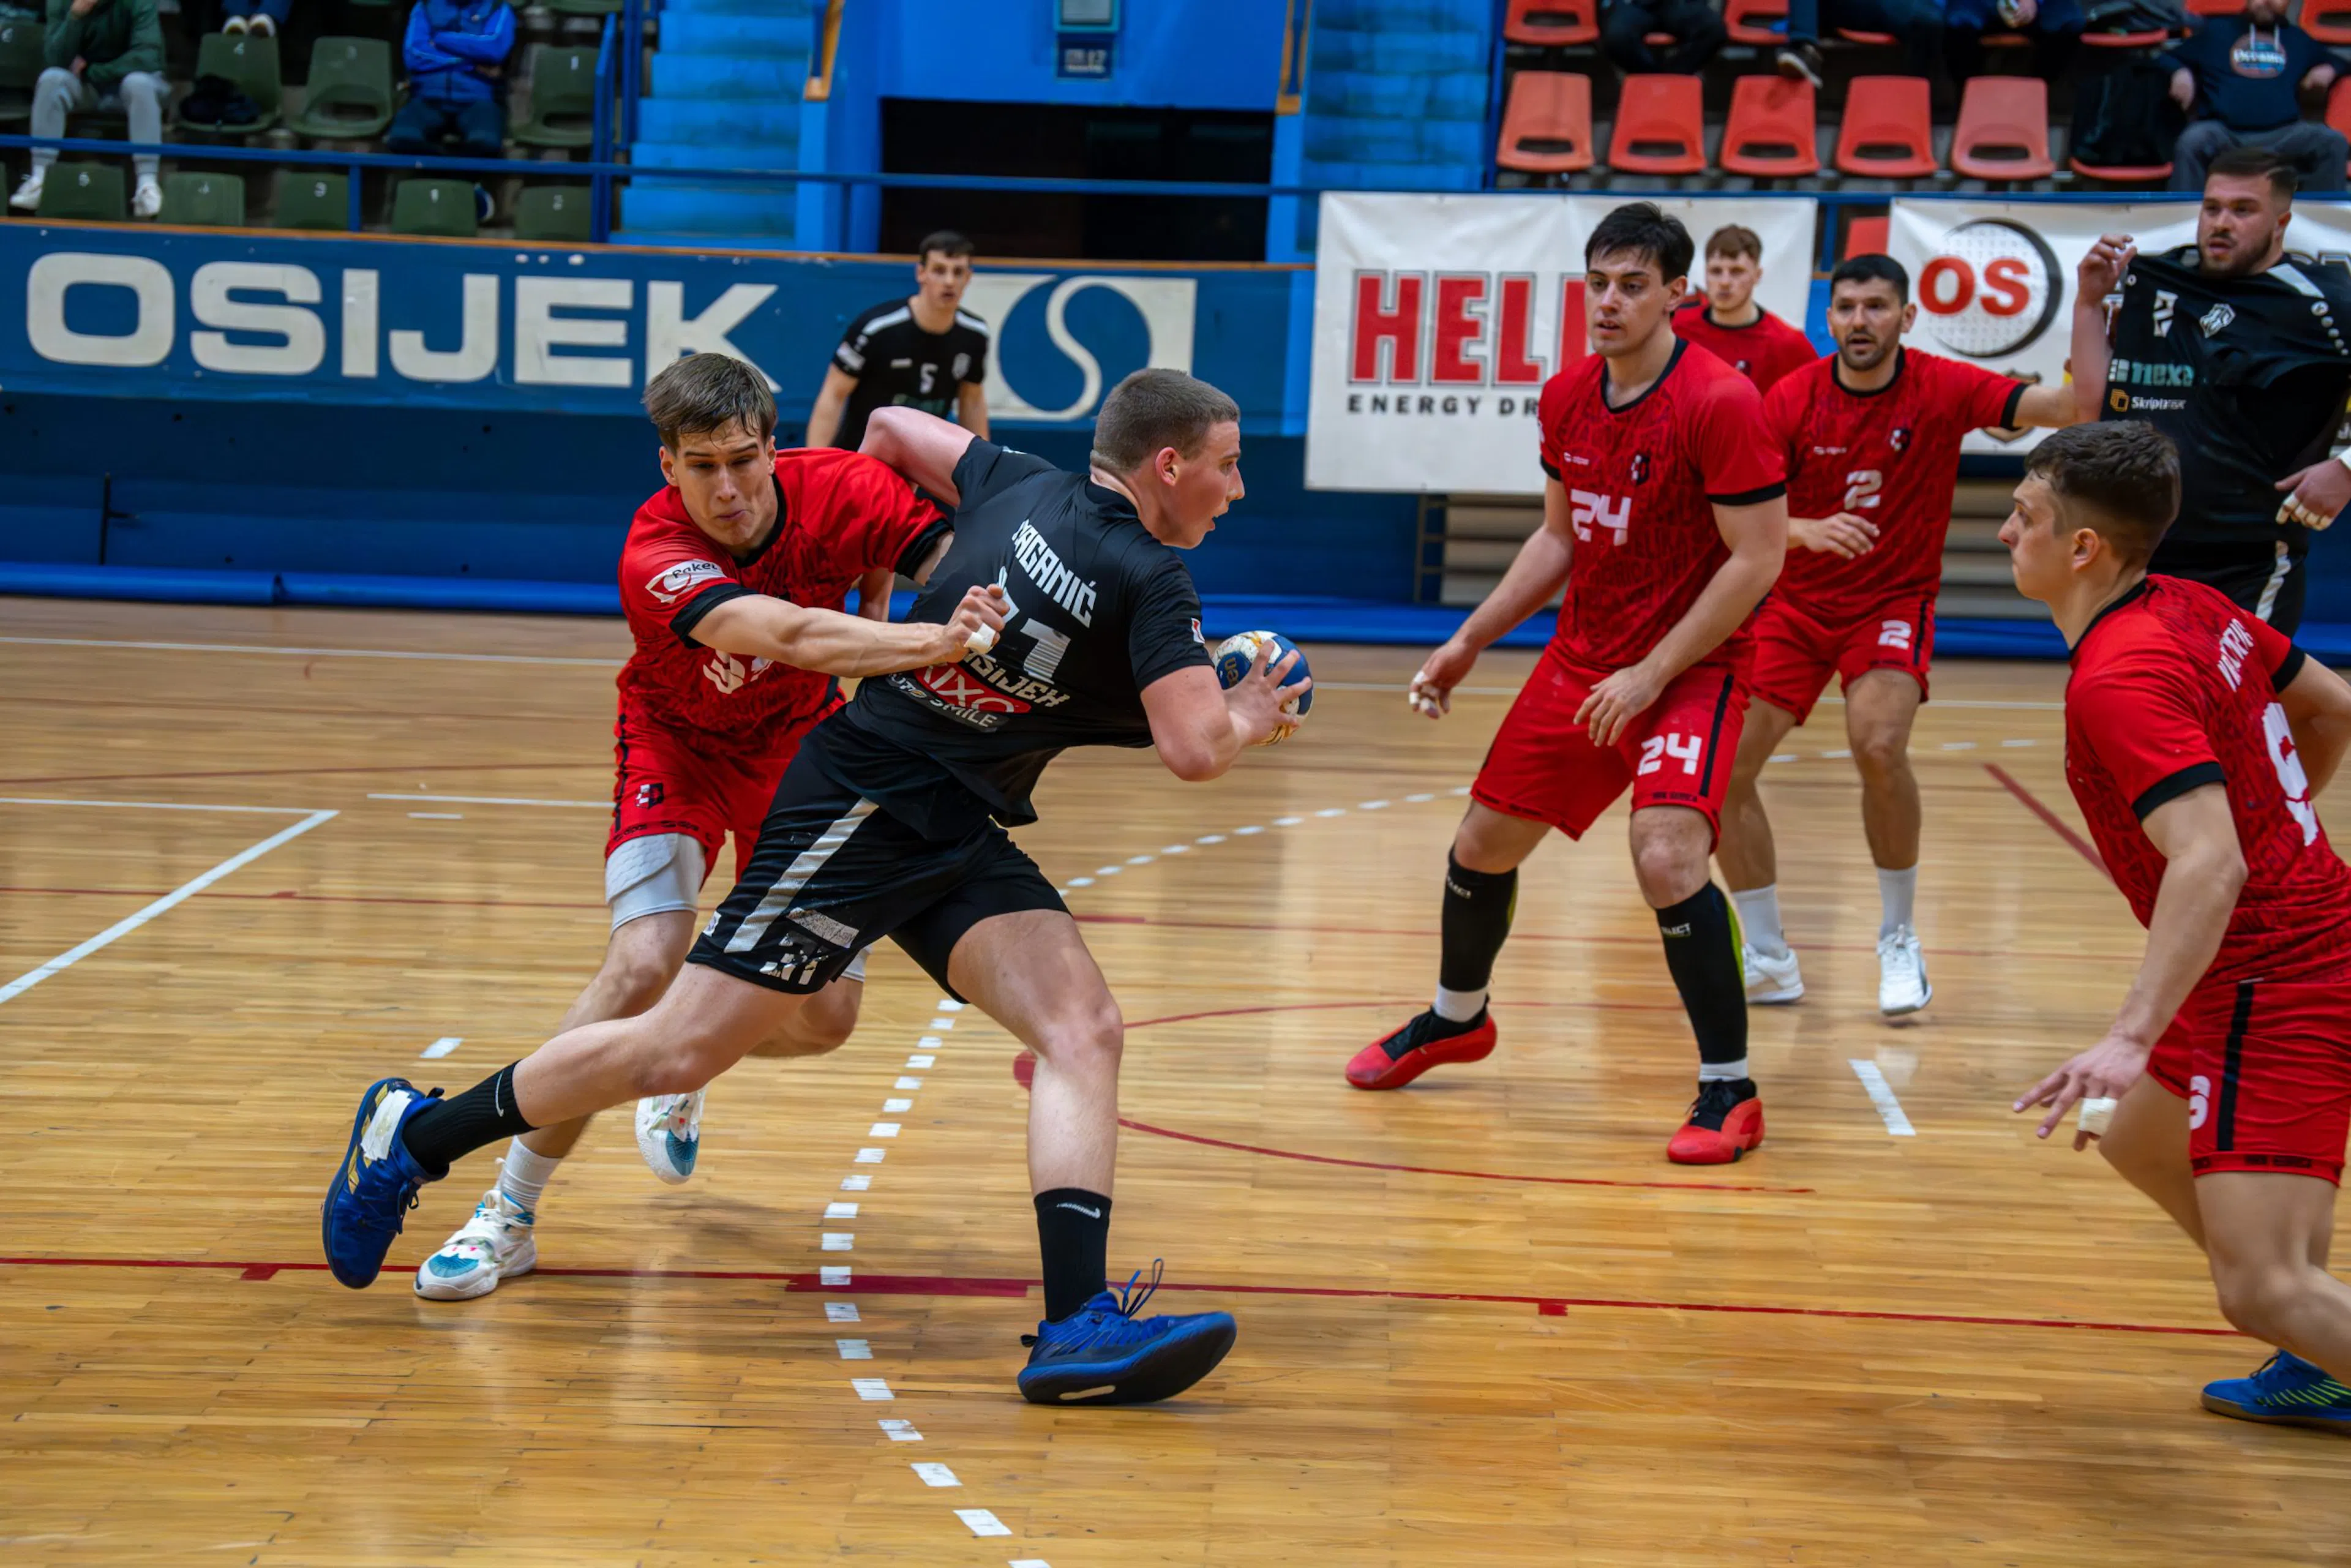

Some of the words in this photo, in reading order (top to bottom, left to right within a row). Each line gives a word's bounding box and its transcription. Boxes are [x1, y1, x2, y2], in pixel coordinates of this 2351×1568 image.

[1918, 256, 2031, 317] OS
[27, 252, 781, 393] OSIJEK
[919, 362, 939, 394] 5
[1348, 394, 1482, 416] ENERGY
[1843, 469, 1883, 510] 2
[1570, 488, 1632, 547] 24
[1878, 620, 1912, 650] 2
[963, 649, 1071, 708] SIJEK
[1637, 732, 1703, 776] 24
